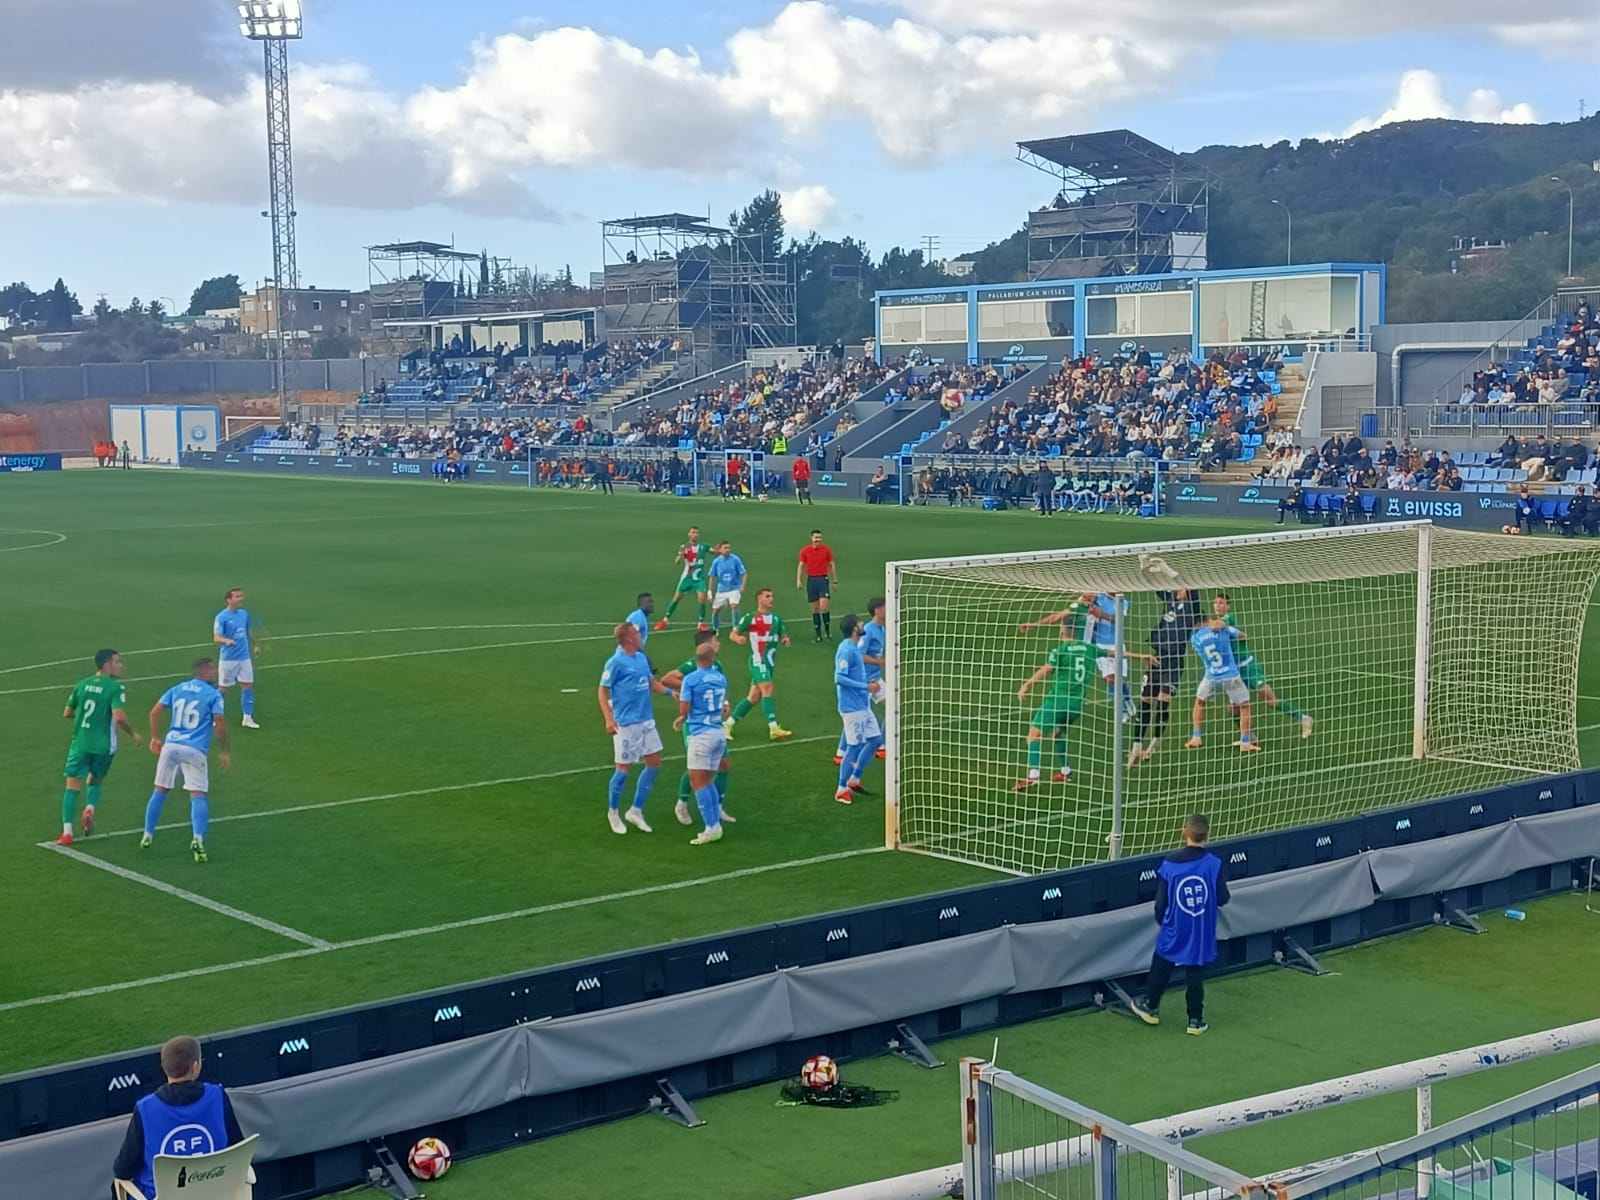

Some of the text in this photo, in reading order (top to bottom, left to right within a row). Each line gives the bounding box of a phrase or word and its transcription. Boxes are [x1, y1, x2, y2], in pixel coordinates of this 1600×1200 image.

[988, 291, 1024, 299] PALLADIUM
[1405, 500, 1462, 517] eivissa
[1203, 645, 1223, 668] 5
[1074, 657, 1085, 682] 5
[703, 688, 726, 711] 17
[81, 699, 96, 728] 2
[173, 699, 200, 729] 16
